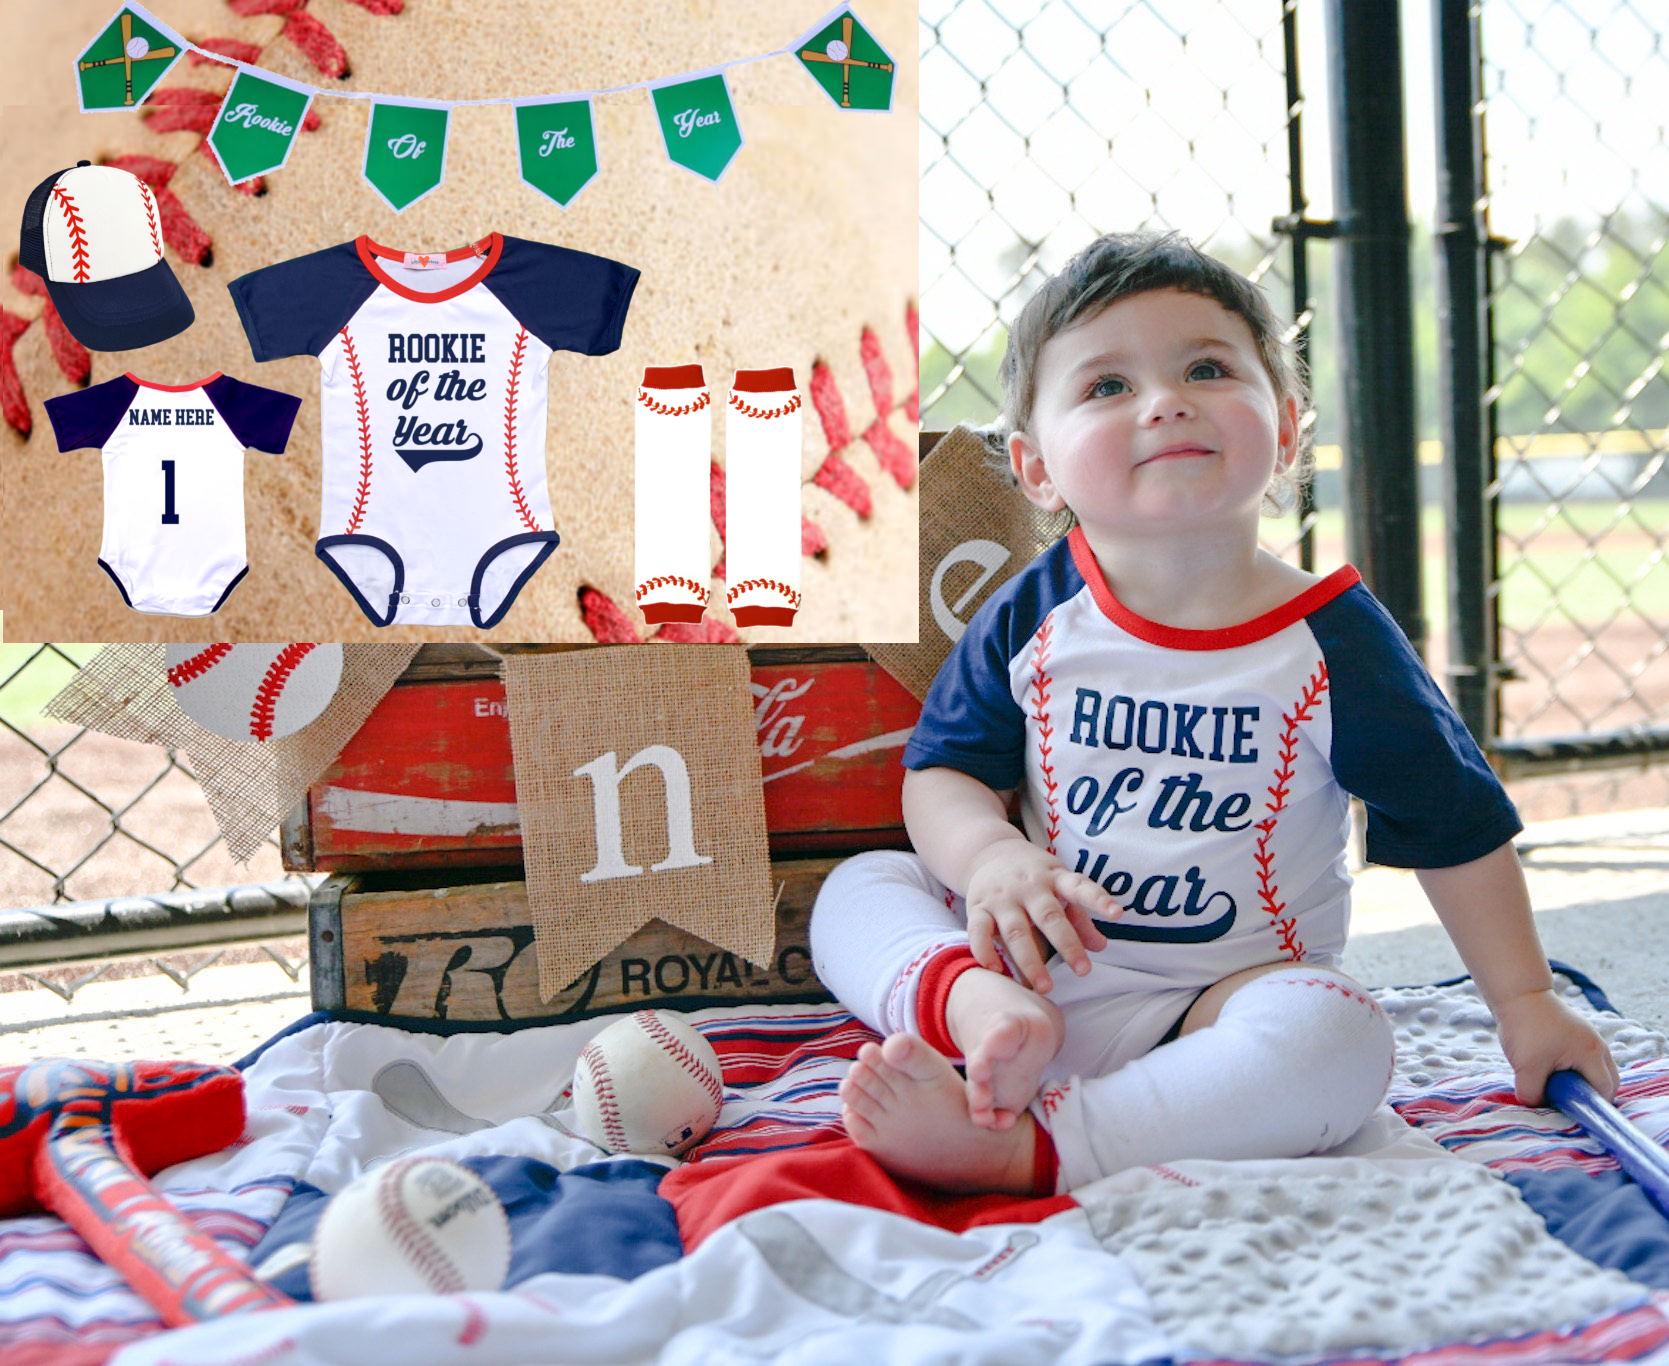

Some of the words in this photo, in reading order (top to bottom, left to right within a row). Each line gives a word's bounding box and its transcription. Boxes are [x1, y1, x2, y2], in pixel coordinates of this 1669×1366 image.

[224, 103, 293, 136] Rookie
[387, 133, 427, 160] Of
[538, 127, 576, 158] The
[673, 107, 722, 138] Year
[388, 333, 486, 363] ROOKIE
[129, 409, 172, 426] NAME
[175, 409, 215, 426] HERE
[386, 370, 431, 410] of
[433, 369, 487, 401] the
[392, 415, 484, 461] Year
[161, 460, 180, 525] 1
[930, 539, 1012, 644] e
[1070, 687, 1260, 763] ROOKIE
[573, 744, 713, 884] n
[1067, 767, 1145, 837] of
[1147, 772, 1253, 832] the
[621, 952, 770, 996] ROYAL
[777, 945, 813, 985] C
